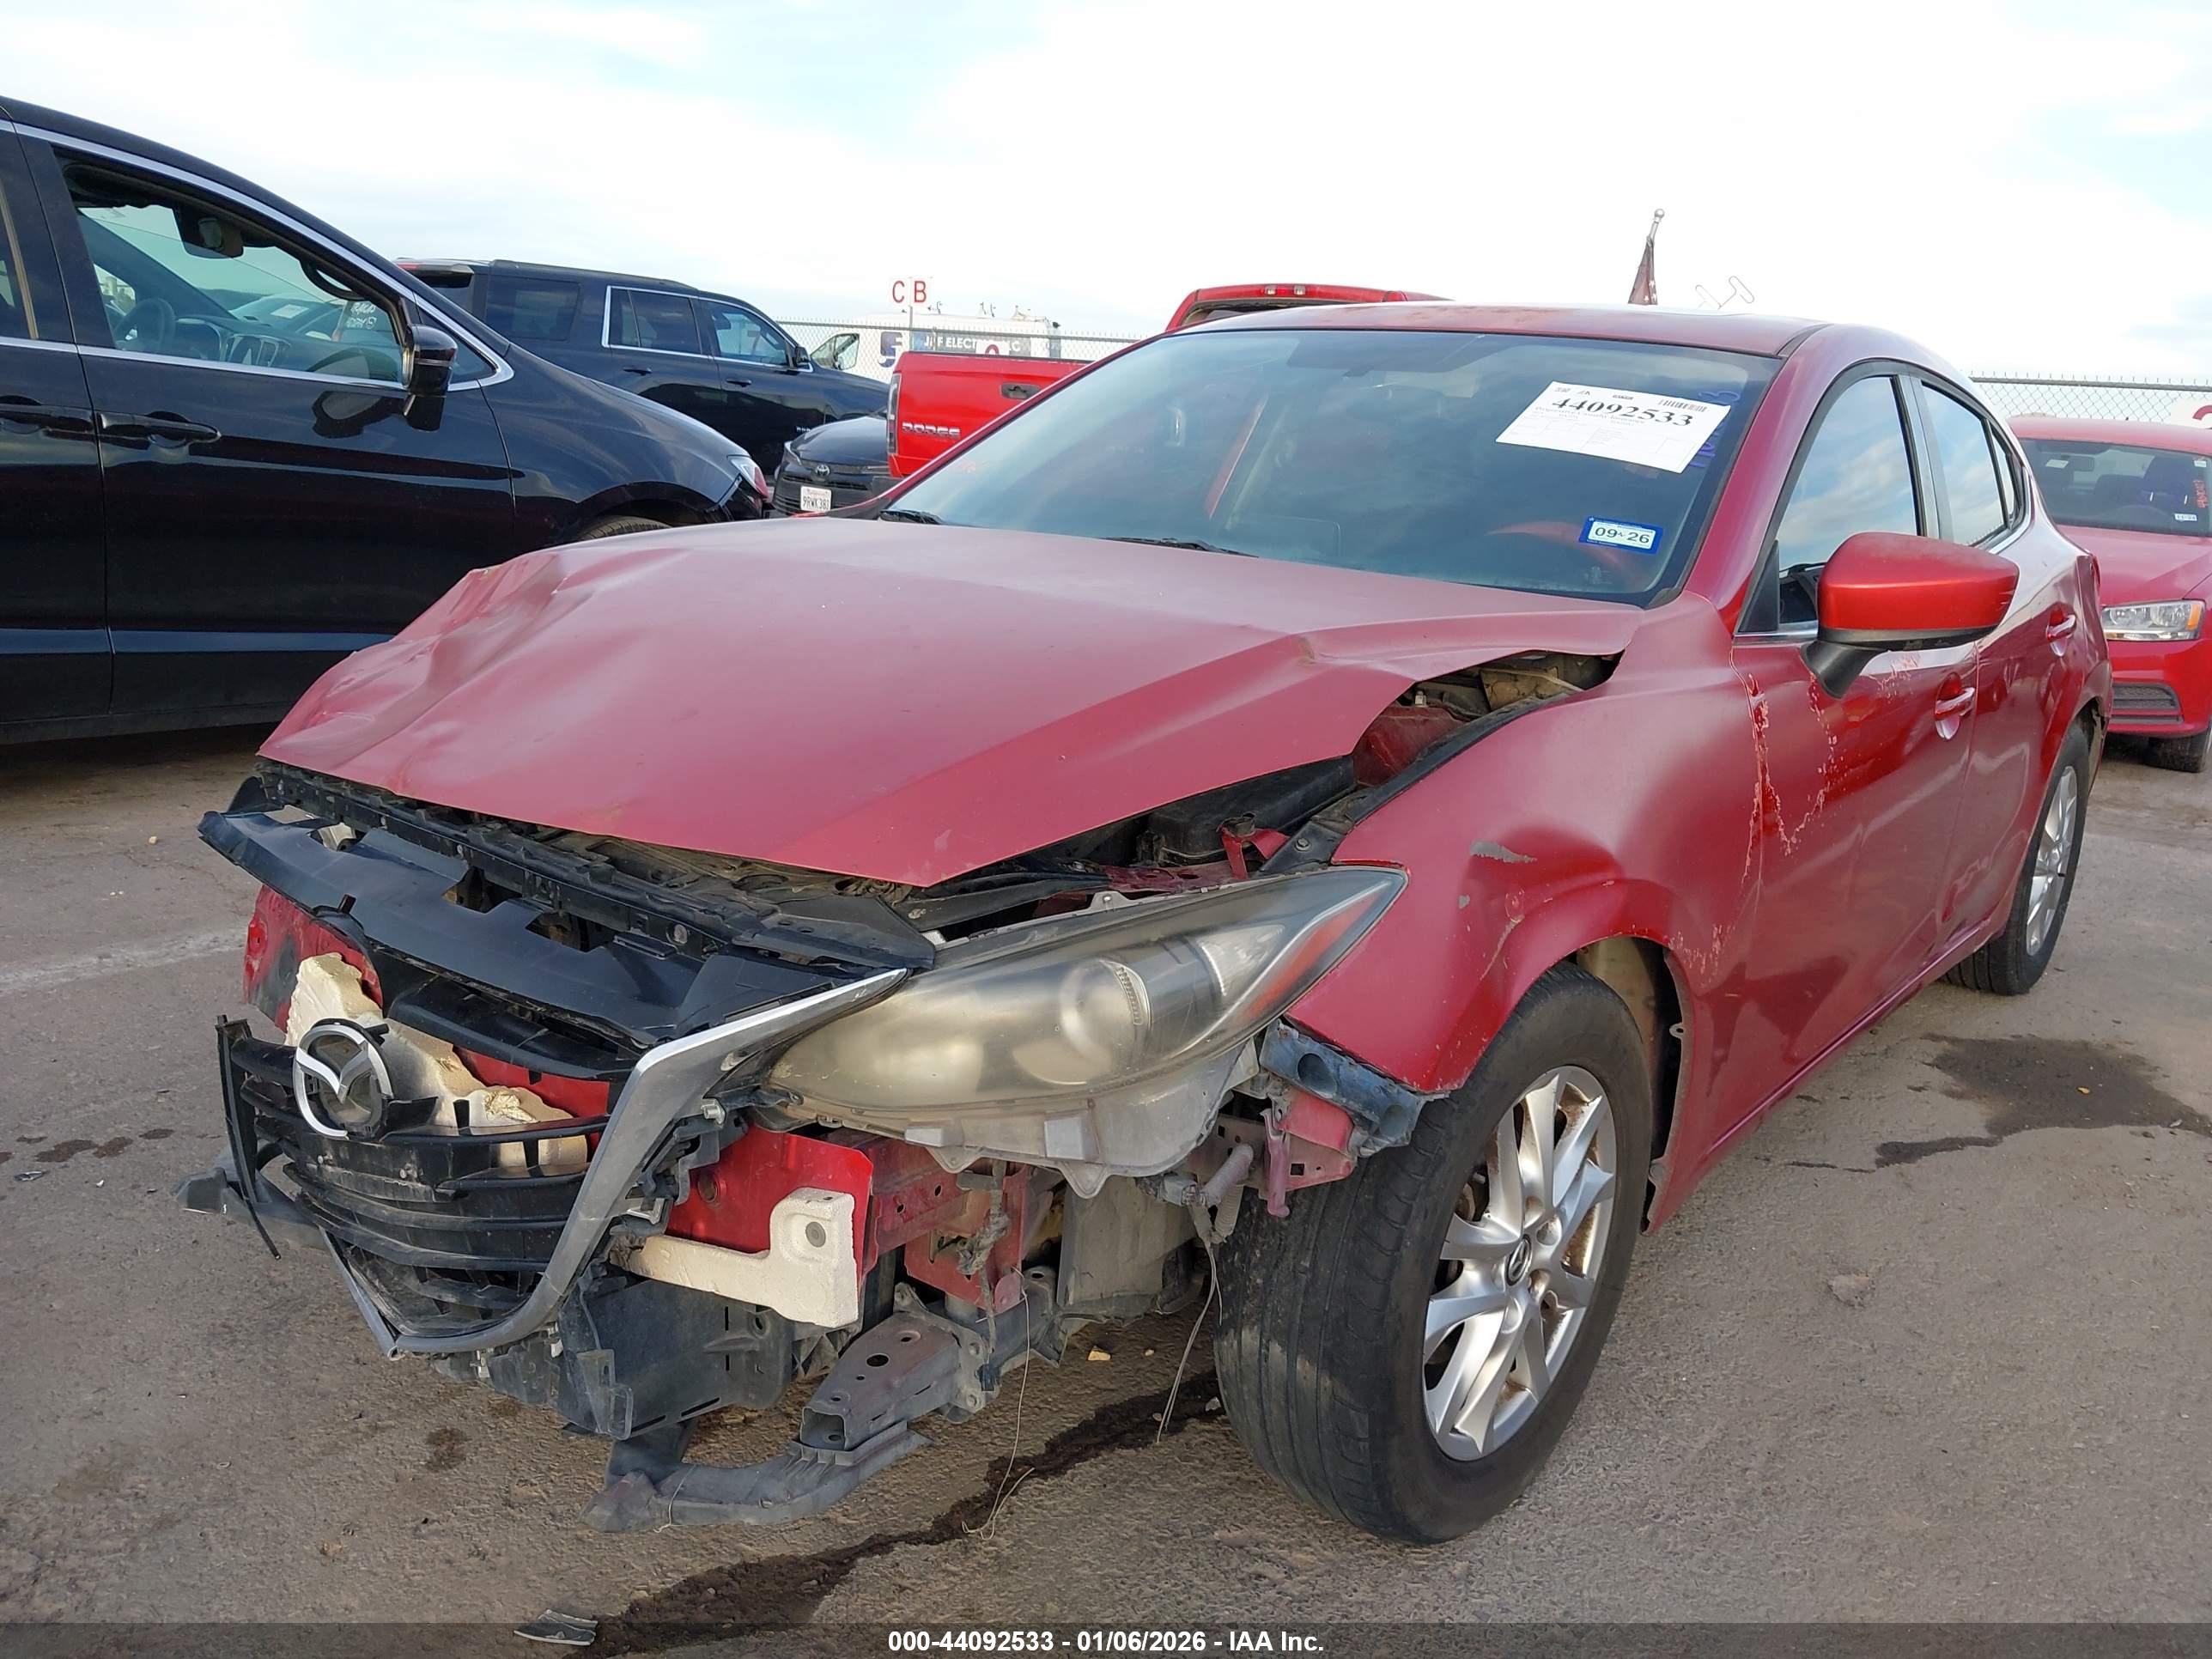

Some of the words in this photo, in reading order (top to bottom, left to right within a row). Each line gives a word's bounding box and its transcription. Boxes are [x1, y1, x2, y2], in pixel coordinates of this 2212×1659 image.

[892, 280, 905, 303] C
[914, 280, 927, 303] B
[1552, 398, 1692, 426] 44092533
[902, 422, 961, 437] DODGE
[1595, 526, 1618, 538] 09
[1626, 532, 1650, 544] 26
